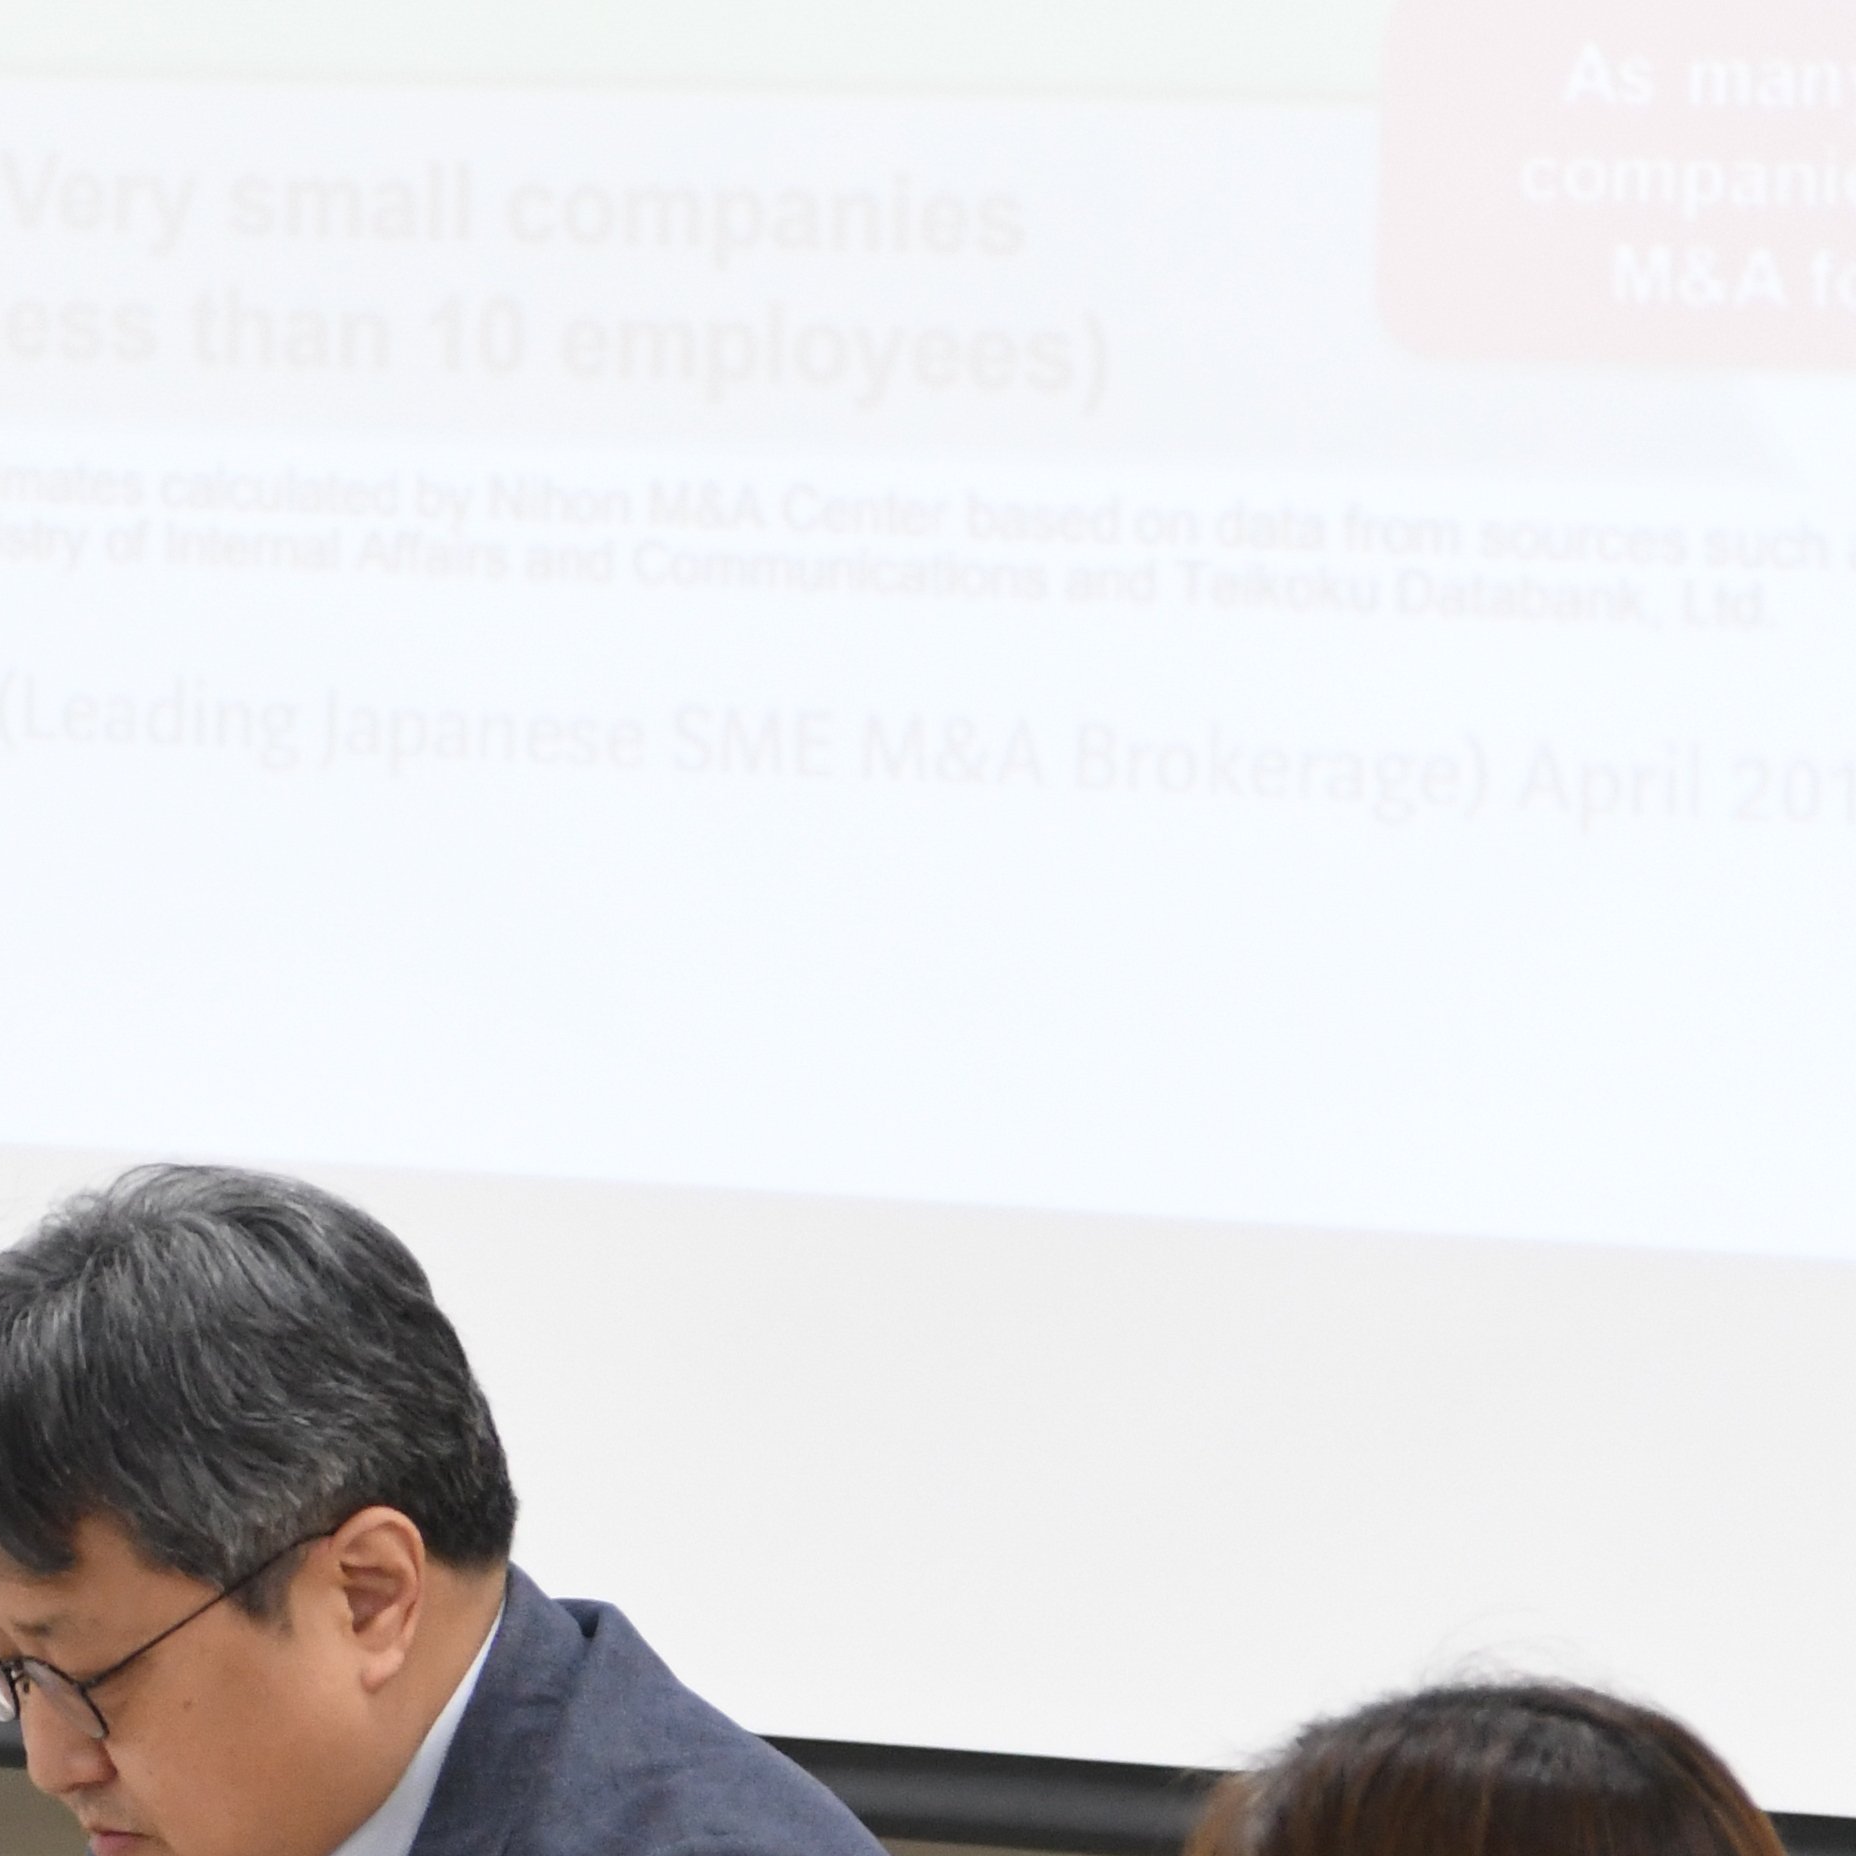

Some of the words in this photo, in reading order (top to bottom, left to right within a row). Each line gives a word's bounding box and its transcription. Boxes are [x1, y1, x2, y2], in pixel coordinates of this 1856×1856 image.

[1561, 38, 1657, 106] As
[1687, 54, 1856, 126] man
[0, 143, 198, 257] Very
[229, 160, 475, 241] small
[508, 172, 1026, 270] companies
[1613, 242, 1788, 309] M&A
[192, 282, 395, 371] than
[426, 290, 528, 375] 10
[560, 300, 1109, 416] employees)
[103, 516, 153, 566] of
[163, 518, 342, 571] Internal
[356, 524, 513, 583] Affairs
[523, 535, 617, 585] and
[631, 537, 1050, 600] Communications
[1064, 558, 1158, 602] and
[1183, 557, 1383, 618] Teikoku
[1394, 566, 1664, 633] Databank,
[1684, 575, 1778, 631] Ltd.
[158, 464, 400, 519] calculated
[414, 465, 474, 530] by
[488, 470, 633, 526] Nihon
[648, 476, 768, 531] M&A
[781, 478, 949, 540] Center
[965, 489, 1122, 546] based
[1132, 504, 1202, 548] on
[1214, 497, 1325, 552] data
[1342, 503, 1462, 557] from
[1478, 517, 1688, 566] sources
[1702, 516, 1830, 570] such
[321, 685, 647, 780] Japanese
[672, 700, 834, 780] SME
[860, 710, 1045, 789] M&A
[1073, 714, 1490, 828] Brokerage)
[1515, 738, 1700, 838] April
